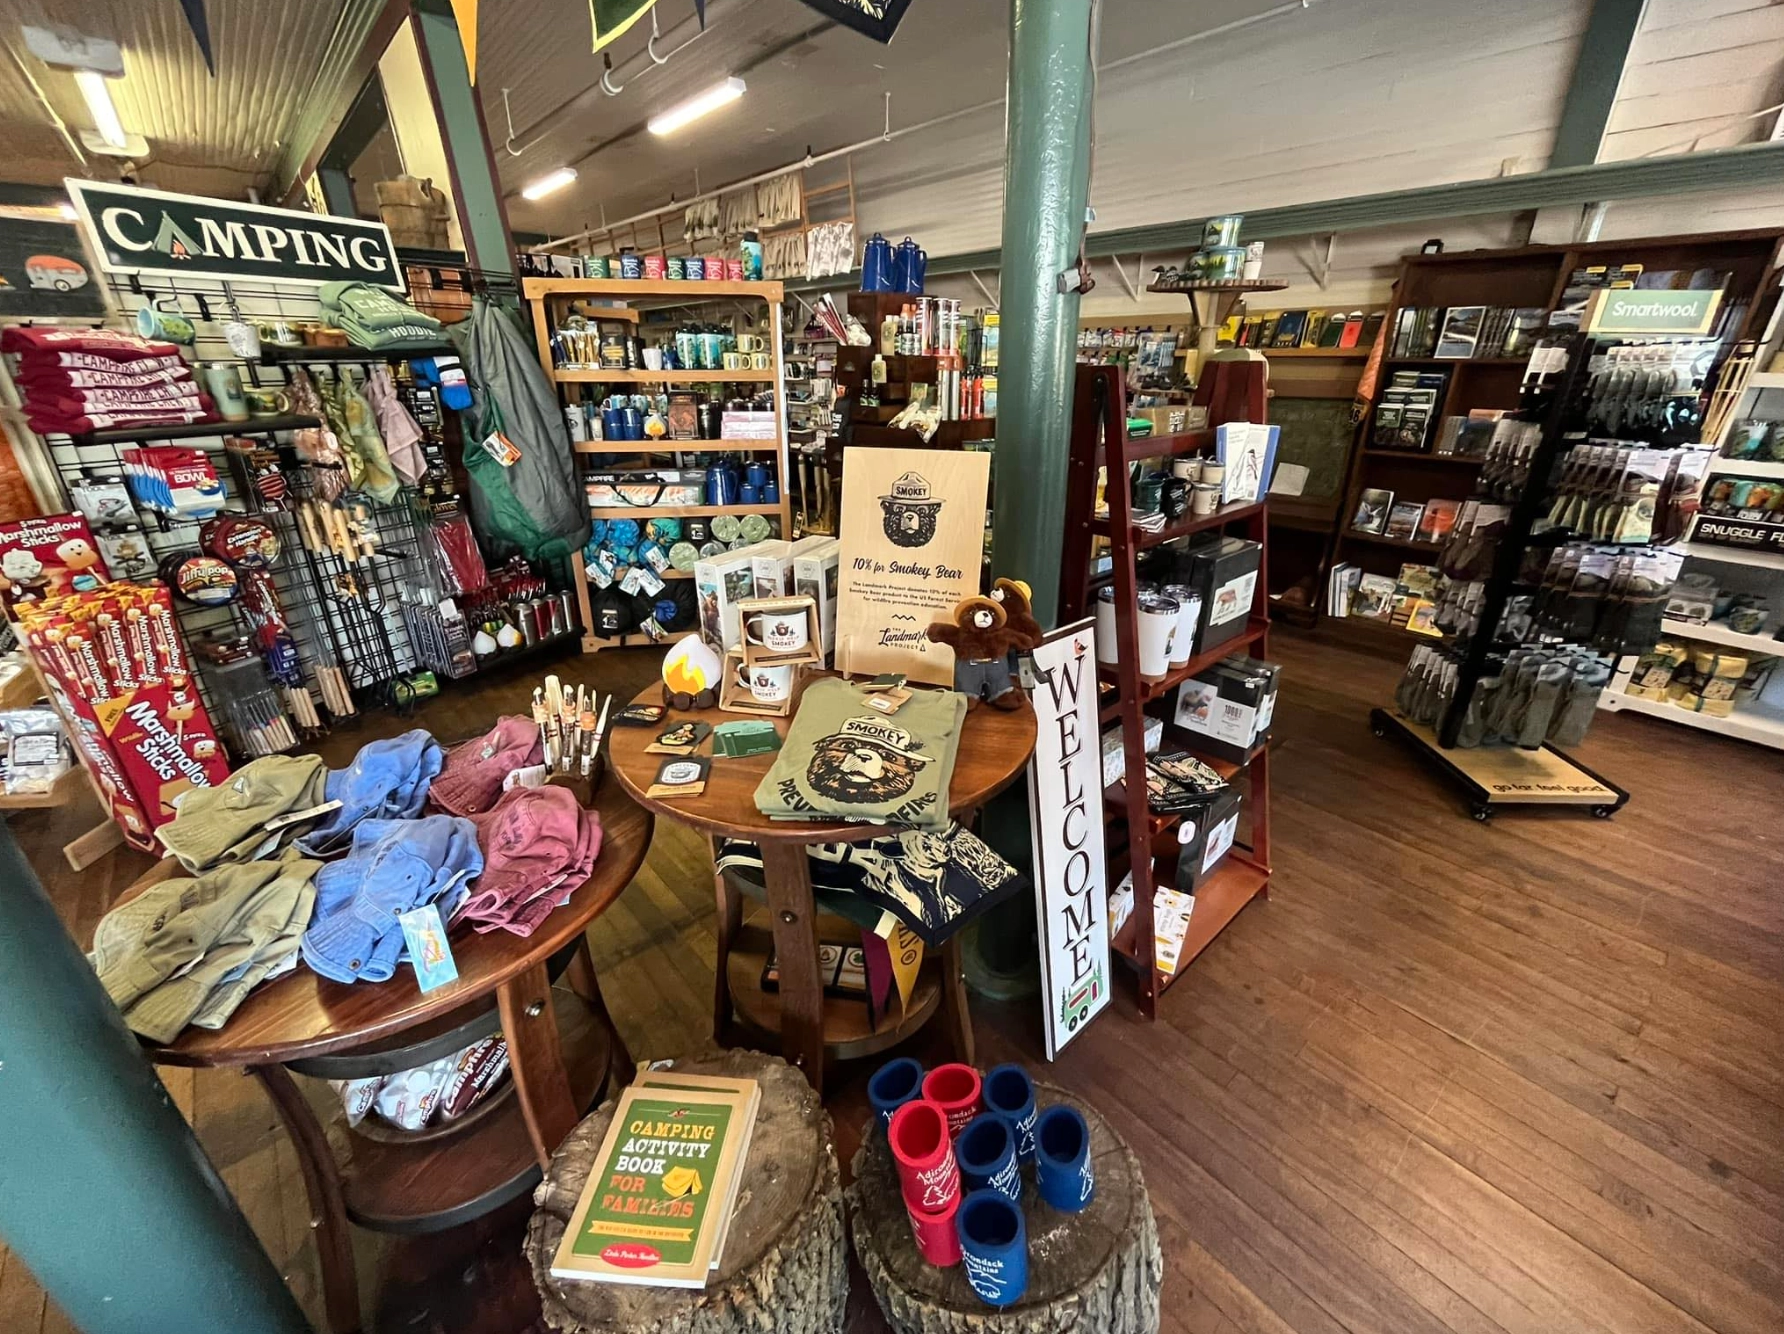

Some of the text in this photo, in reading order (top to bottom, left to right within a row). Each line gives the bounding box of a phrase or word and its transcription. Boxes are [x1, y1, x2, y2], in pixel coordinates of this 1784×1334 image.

[174, 472, 206, 483] BOWL
[895, 487, 927, 497] SMOKEY
[21, 534, 60, 548] Sticks
[1700, 523, 1766, 540] SNUGGLE
[852, 557, 964, 580] 10% for Smokey Bear
[138, 615, 156, 675] Marshmallow
[161, 610, 181, 667] Marshmallow
[110, 620, 132, 681] Marshmallow
[81, 641, 110, 698] Marshmallow
[846, 722, 906, 745] SMOKEY
[135, 738, 176, 780] Sticks
[1045, 655, 1096, 987] WELCOME
[445, 1038, 494, 1110] Campfire
[471, 1042, 508, 1088] Marshmall
[630, 1120, 715, 1141] CAMPING
[622, 1138, 711, 1158] ACTIVITY
[615, 1155, 667, 1175] BOOK
[610, 1175, 646, 1192] FOR
[601, 1194, 695, 1218] FAMILIES
